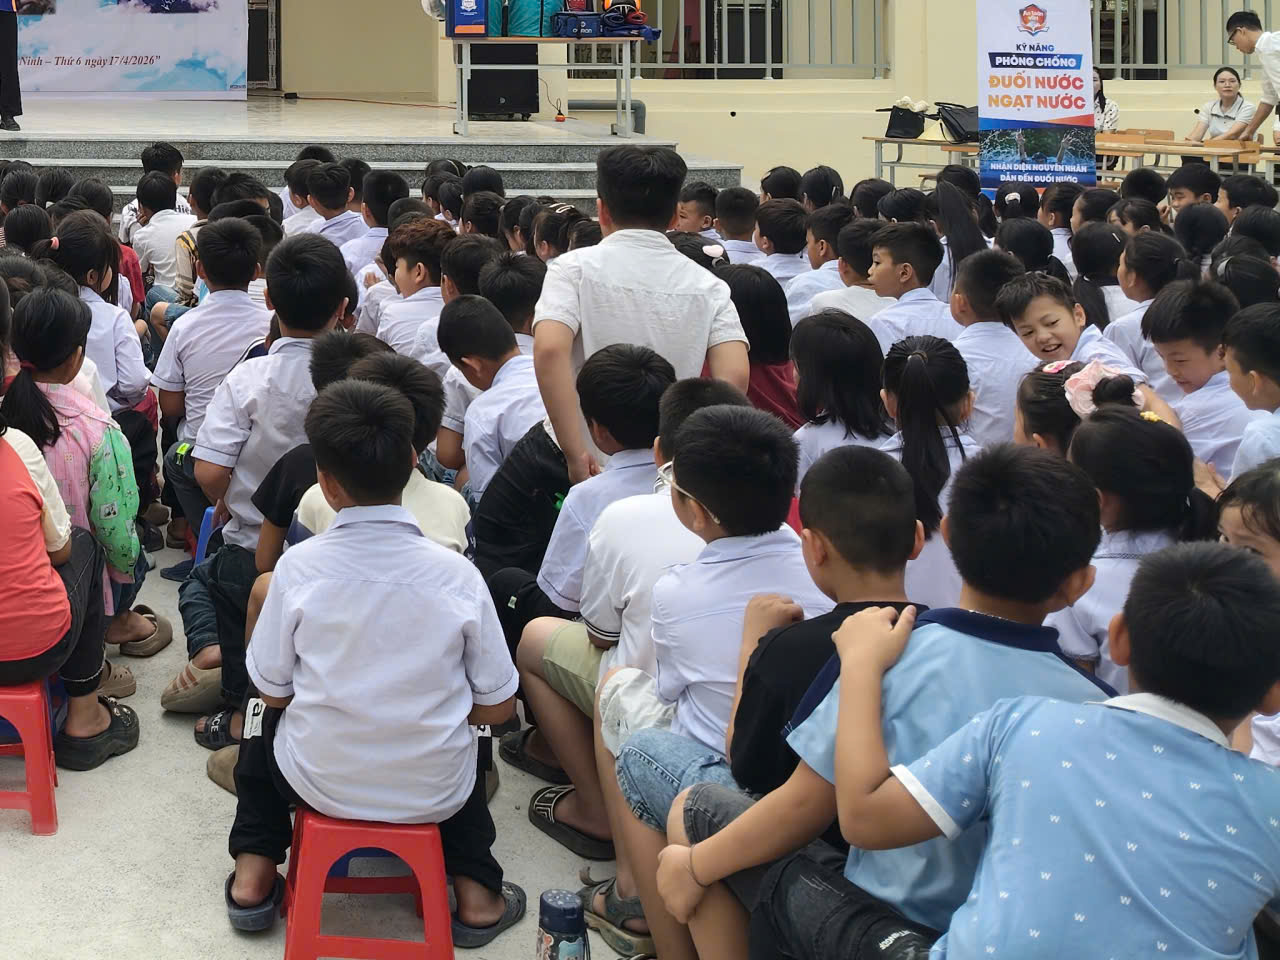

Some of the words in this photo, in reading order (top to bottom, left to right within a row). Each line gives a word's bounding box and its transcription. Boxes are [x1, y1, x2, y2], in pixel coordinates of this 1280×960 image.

[1016, 43, 1028, 52] KỸ
[1029, 43, 1055, 52] NĂNG
[19, 56, 43, 66] Ninh
[54, 55, 75, 66] Thứ
[76, 56, 82, 66] 6
[84, 56, 108, 68] ngày
[995, 54, 1035, 67] PHÒNG
[1036, 54, 1077, 67] CHỐNG
[988, 71, 1031, 89] ĐUỐI
[1034, 74, 1084, 90] NƯỚC
[988, 94, 1033, 111] NGẠT
[1037, 93, 1086, 110] NƯỚC
[990, 162, 1012, 172] NHẬN
[1013, 162, 1031, 172] DIỆN
[1032, 163, 1064, 172] NGUYÊN
[1065, 163, 1087, 173] NHÂN
